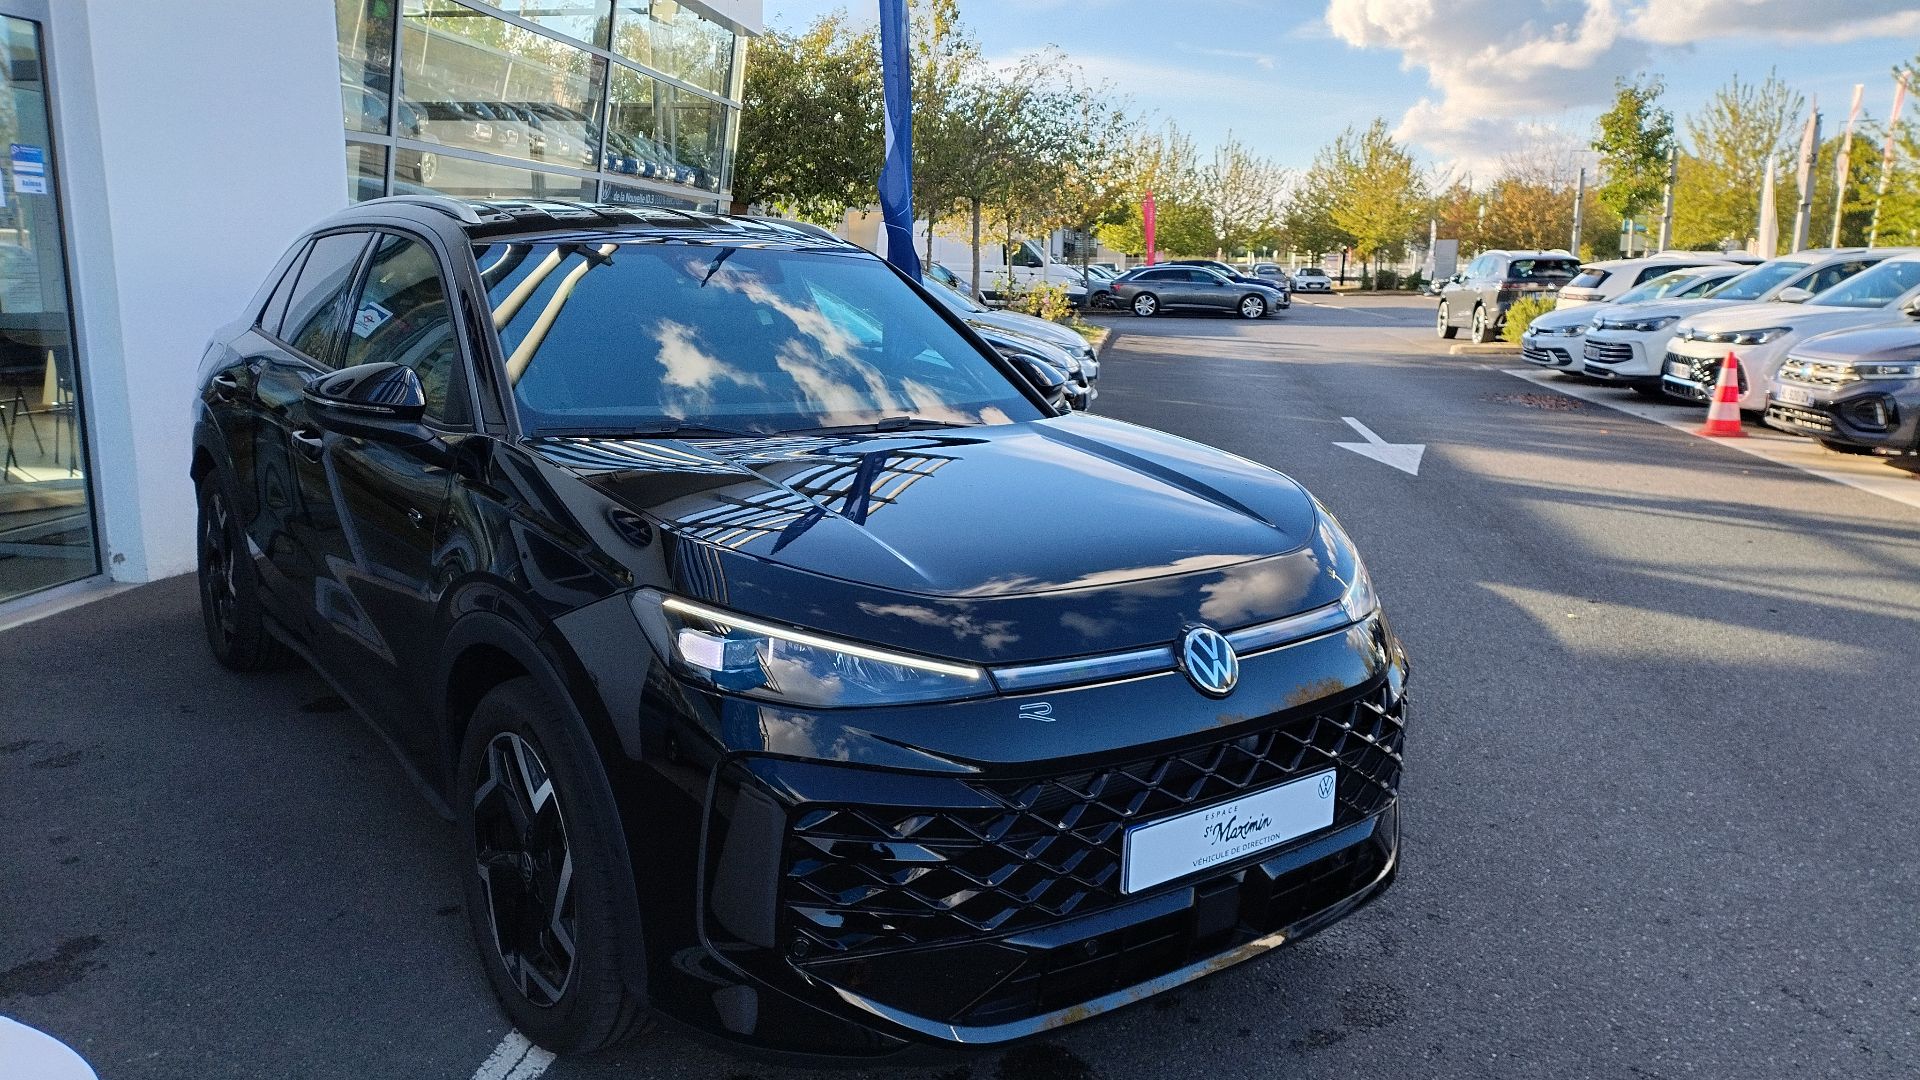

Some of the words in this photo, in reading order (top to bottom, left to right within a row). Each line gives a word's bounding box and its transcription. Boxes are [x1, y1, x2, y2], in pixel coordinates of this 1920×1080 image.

[613, 191, 620, 201] de
[620, 191, 625, 202] la
[625, 192, 645, 204] Nouvelle
[1204, 805, 1238, 821] ESPACE
[1203, 824, 1213, 838] St
[1211, 813, 1273, 846] Maximin
[1192, 849, 1230, 867] VÉHICULE
[1230, 846, 1241, 855] DE
[1242, 832, 1281, 851] DIRECTION
